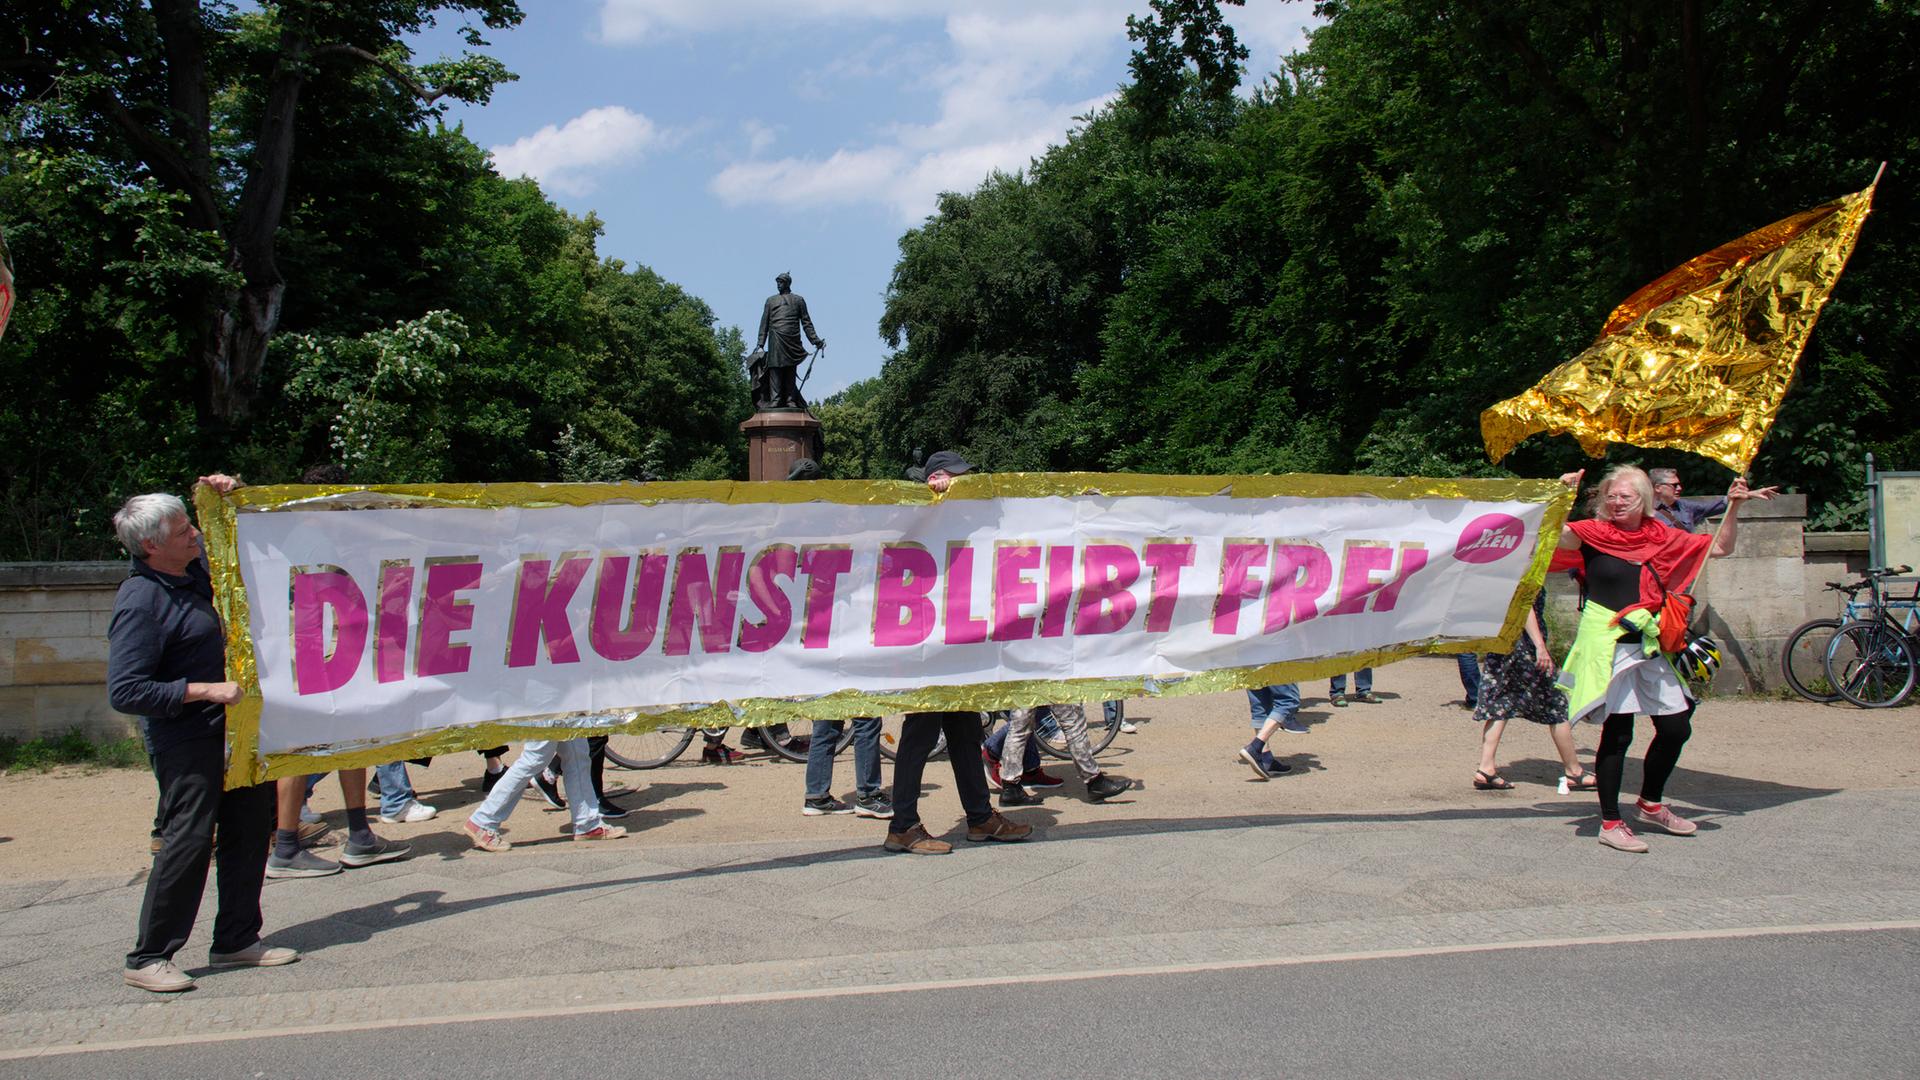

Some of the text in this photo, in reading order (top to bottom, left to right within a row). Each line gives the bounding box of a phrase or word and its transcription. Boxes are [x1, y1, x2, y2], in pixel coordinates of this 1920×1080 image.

[289, 536, 1429, 696] DIE KUNST BLEIBT FREI
